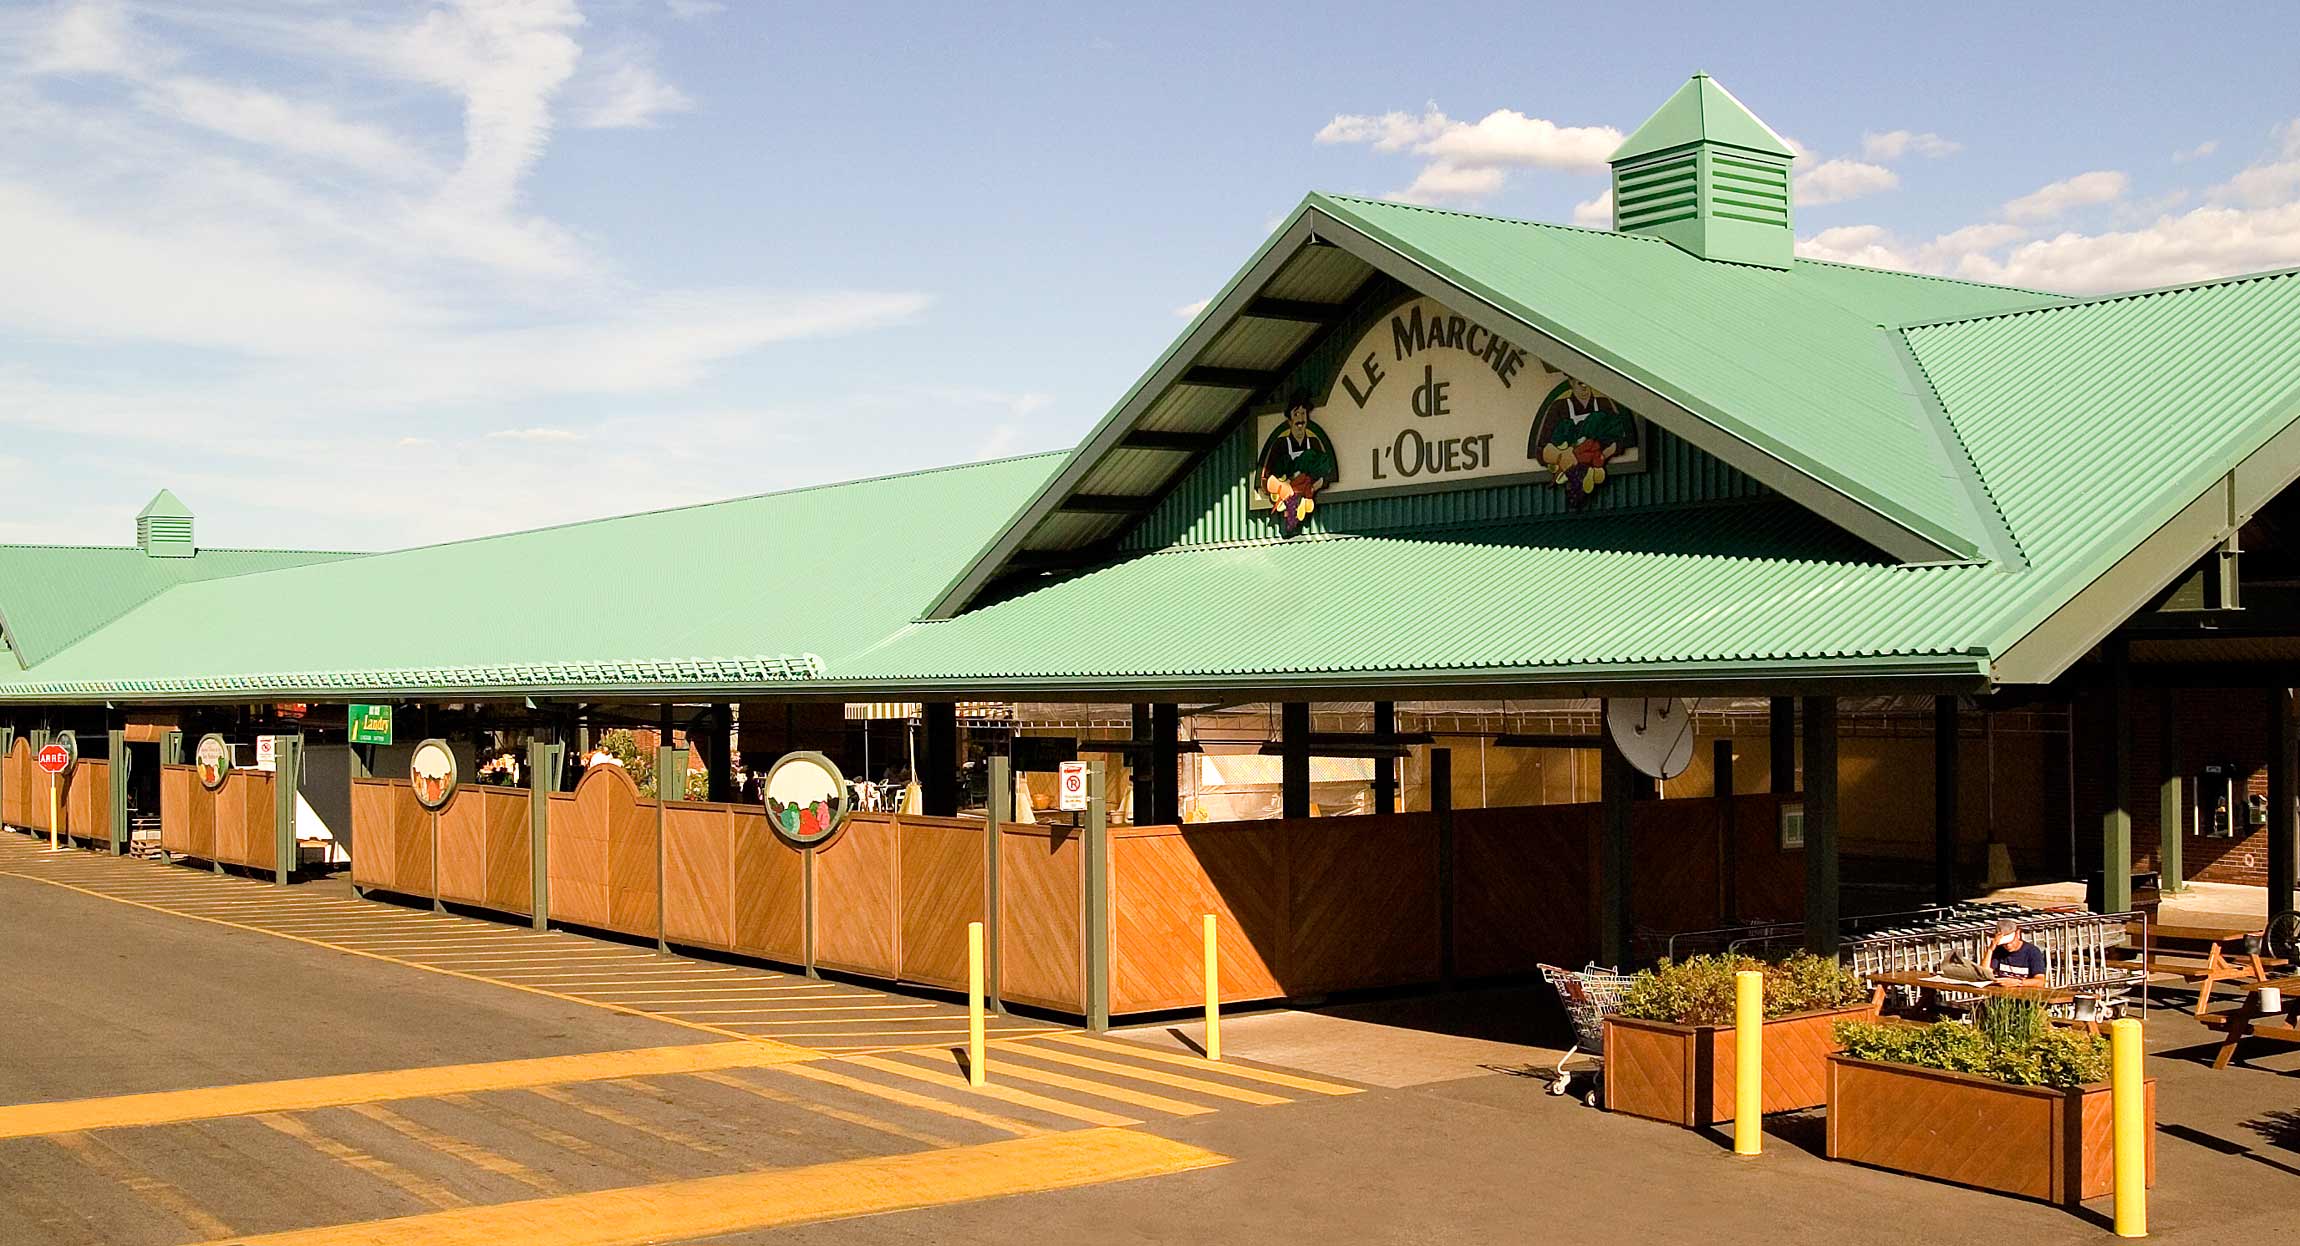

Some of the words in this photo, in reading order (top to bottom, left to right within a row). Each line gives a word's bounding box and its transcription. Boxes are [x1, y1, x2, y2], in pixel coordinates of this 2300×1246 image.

[1342, 352, 1385, 409] LE
[1392, 305, 1527, 389] MARCHÉ
[1372, 429, 1494, 480] L'OUEST
[363, 714, 389, 734] Landry
[40, 753, 66, 763] ARRÊT
